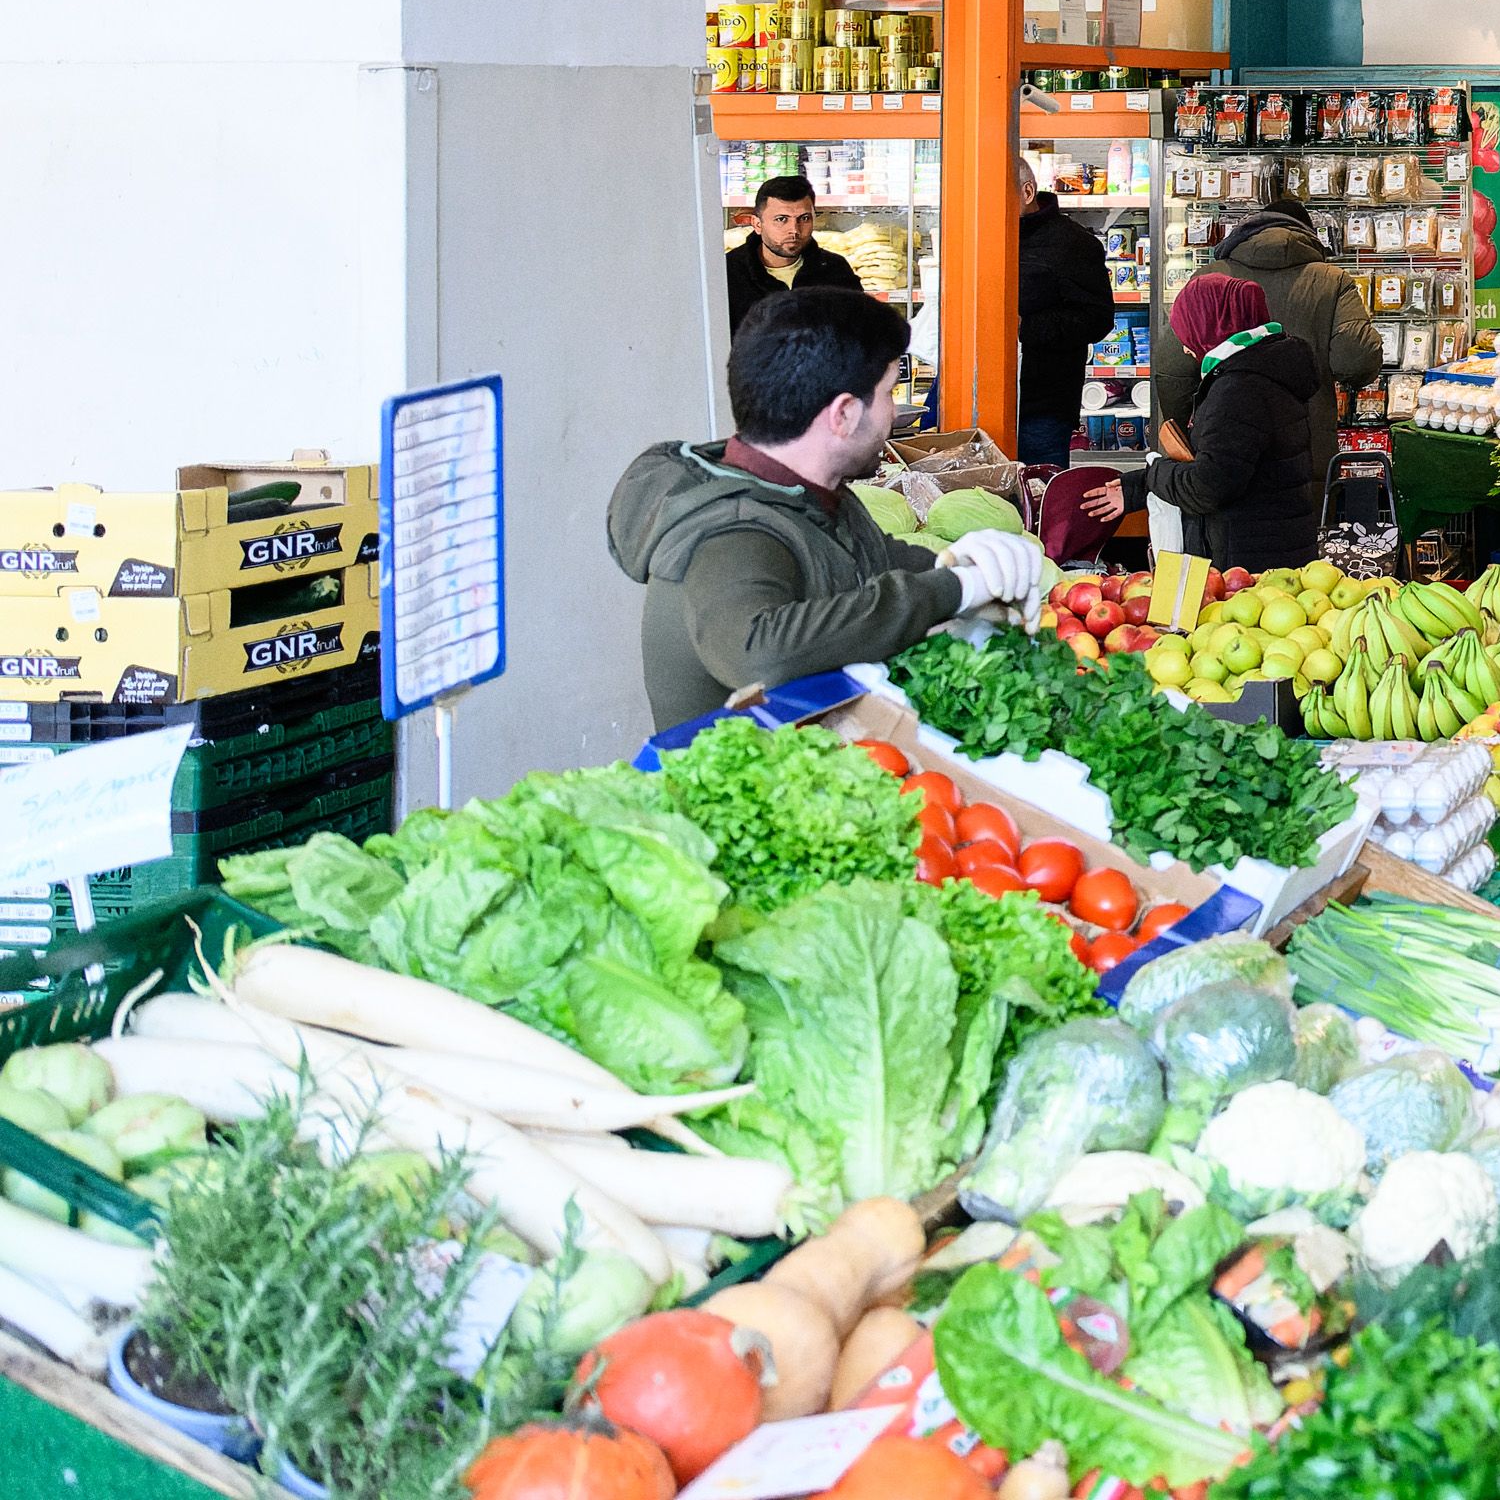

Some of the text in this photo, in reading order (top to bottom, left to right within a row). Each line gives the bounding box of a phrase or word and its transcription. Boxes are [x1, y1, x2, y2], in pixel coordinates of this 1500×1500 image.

[834, 21, 863, 34] fresh
[1104, 344, 1120, 355] Kiri
[248, 532, 316, 564] GNR
[1, 551, 55, 571] GNR
[251, 631, 318, 666] GNR
[1, 657, 58, 677] GNR
